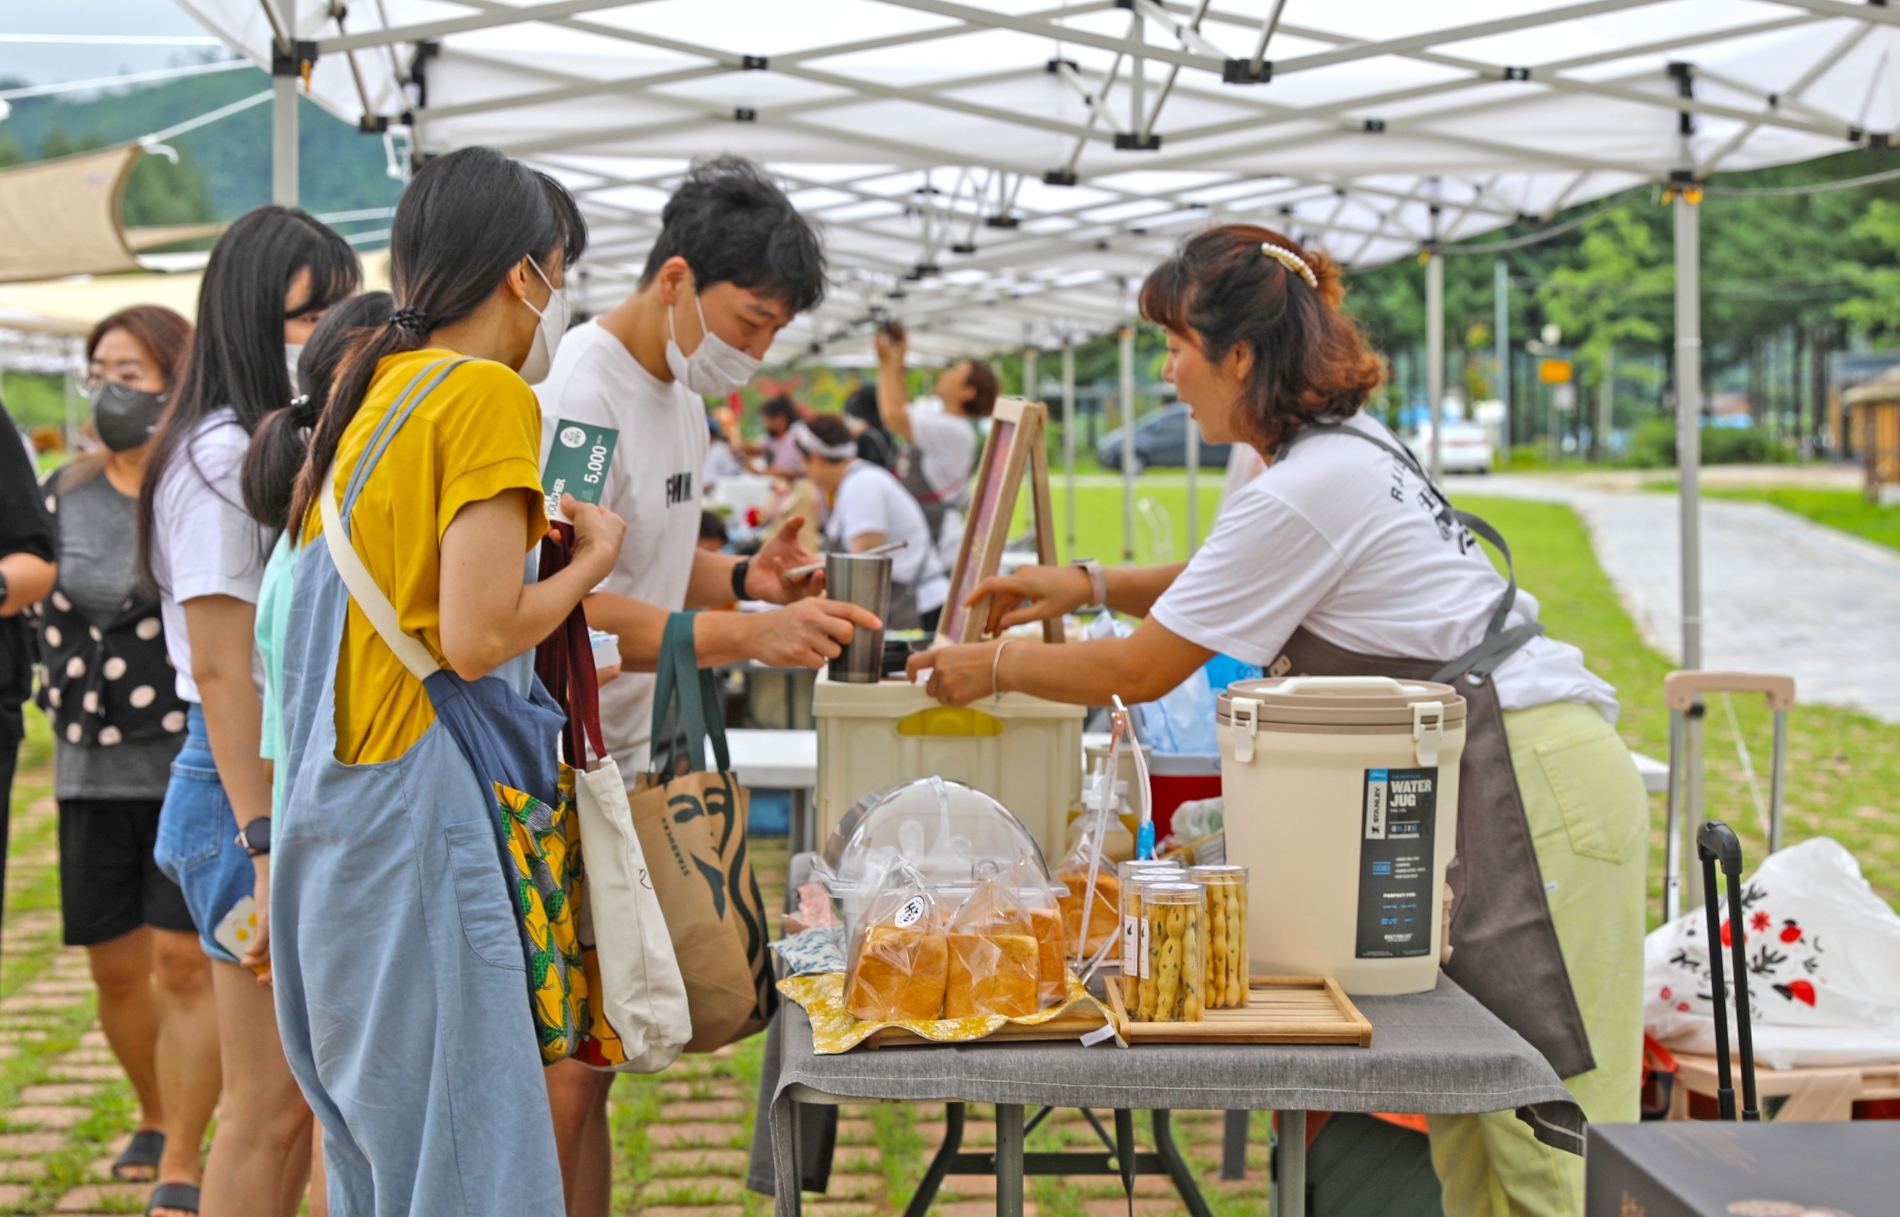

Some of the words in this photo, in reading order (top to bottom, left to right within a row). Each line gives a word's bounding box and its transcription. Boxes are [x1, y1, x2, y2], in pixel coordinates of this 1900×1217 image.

[583, 445, 607, 484] 5,000
[546, 478, 566, 516] VOUCHER
[1390, 779, 1432, 793] WATER
[1390, 793, 1416, 807] JUG
[1373, 787, 1381, 823] STANLEY
[661, 817, 690, 876] STARBUCKS
